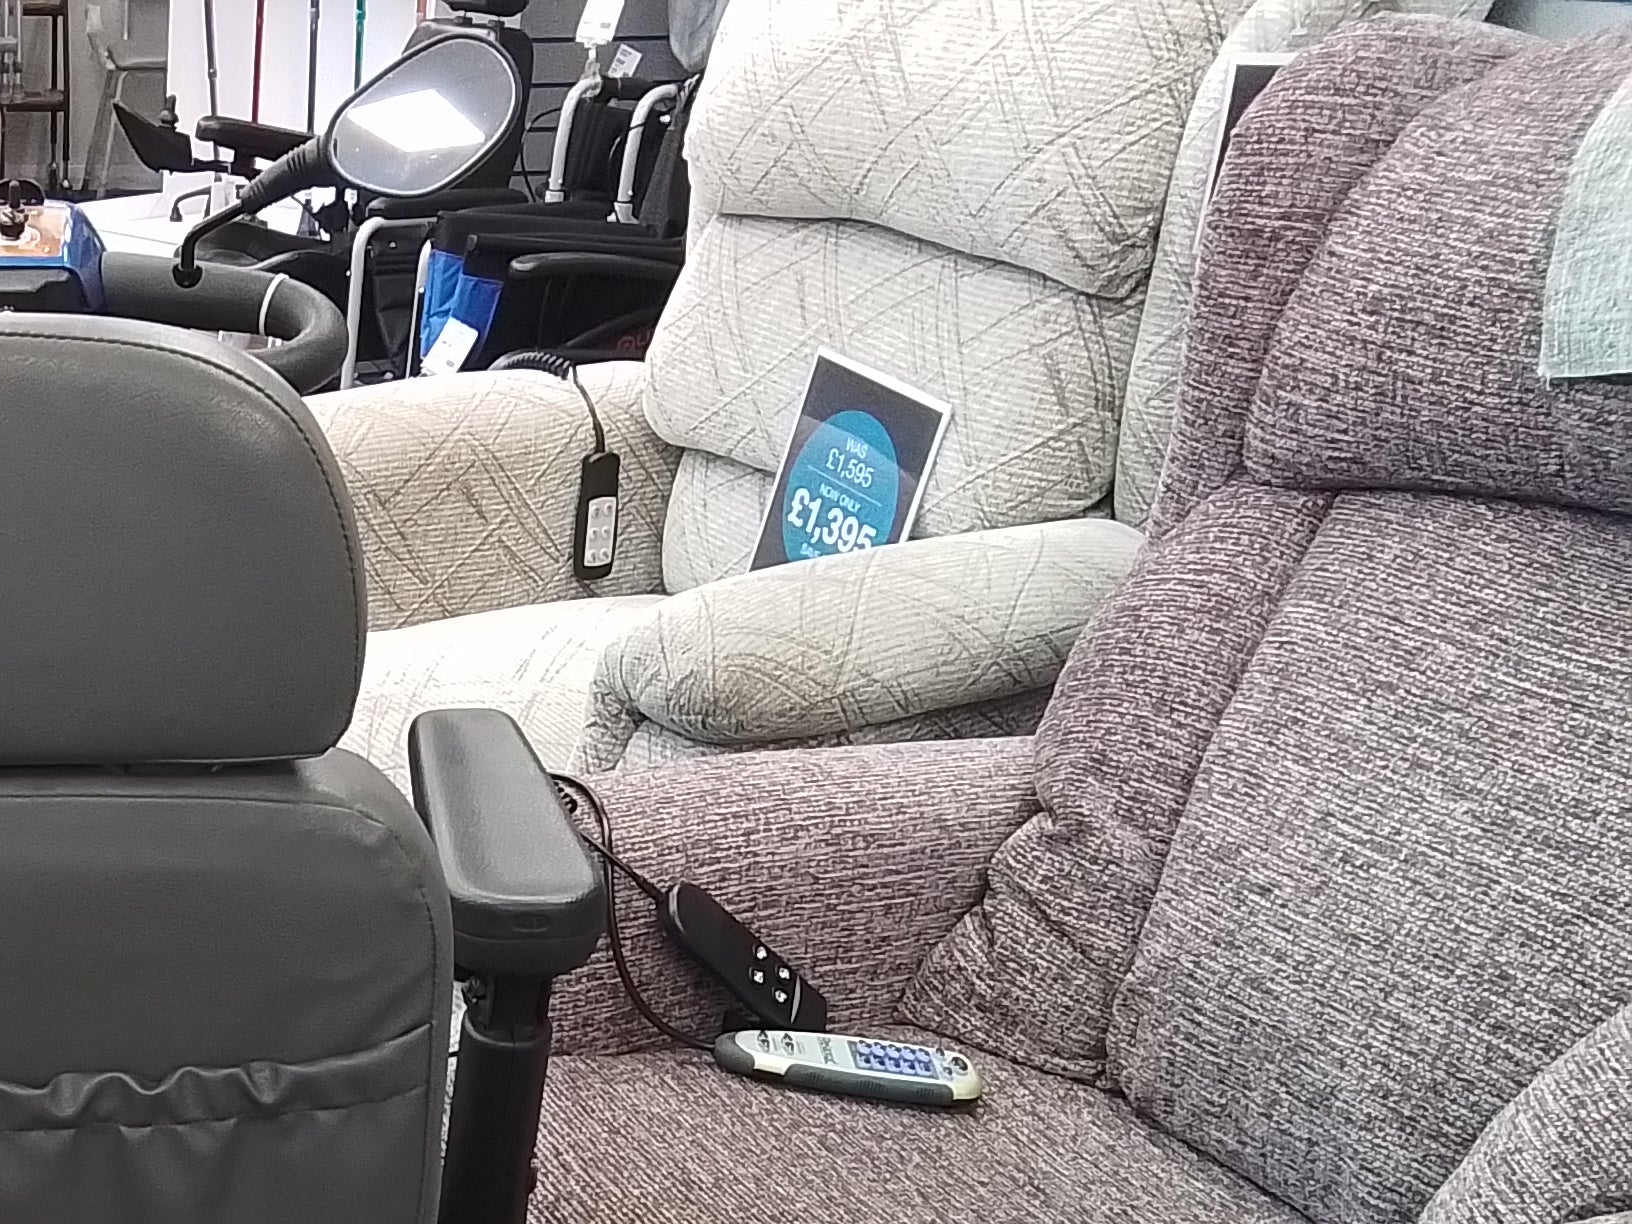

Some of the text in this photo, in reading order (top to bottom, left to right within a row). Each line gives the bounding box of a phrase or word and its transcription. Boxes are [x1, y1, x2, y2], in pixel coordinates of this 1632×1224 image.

[846, 437, 868, 459] WAS
[825, 447, 875, 488] £1,595
[819, 482, 862, 513] NOW ONLY
[787, 487, 878, 553] £1,395
